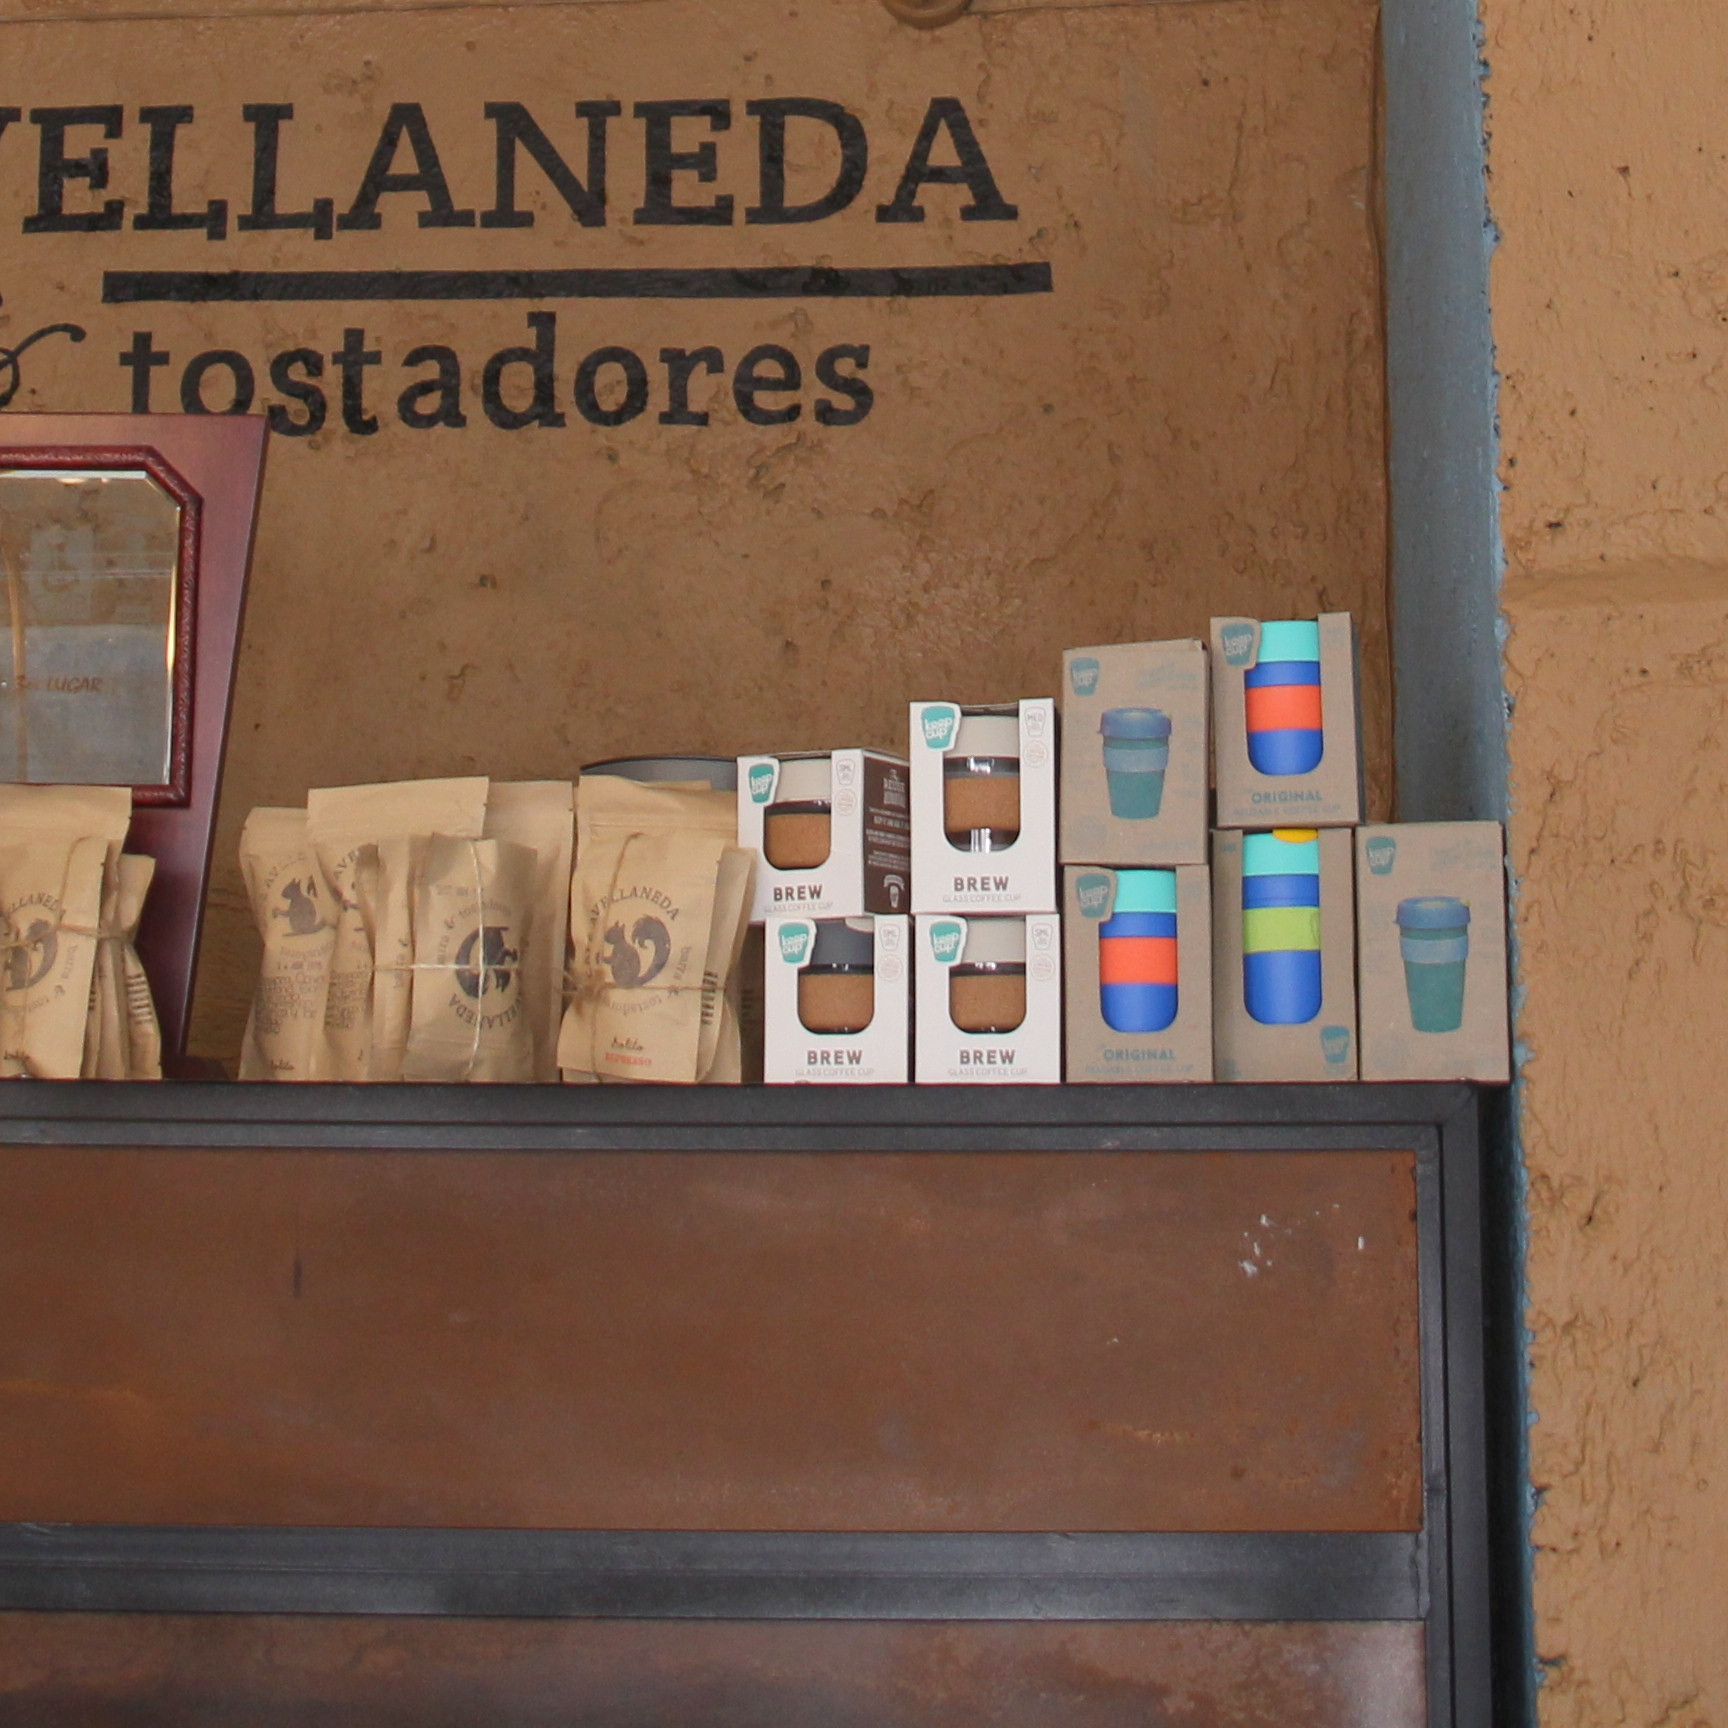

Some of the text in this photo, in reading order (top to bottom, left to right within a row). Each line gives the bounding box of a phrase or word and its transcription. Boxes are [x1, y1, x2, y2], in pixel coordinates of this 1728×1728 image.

[119, 311, 874, 438] tostadores
[925, 717, 953, 731] keep
[926, 728, 947, 740] cup
[1251, 790, 1323, 804] ORIGINAL
[953, 876, 1009, 892] BREW
[773, 884, 823, 902] BREW
[781, 933, 808, 945] keep
[933, 932, 960, 944] keep
[782, 942, 802, 955] cup
[934, 941, 955, 954] cup
[807, 1049, 863, 1065] BREW
[959, 1049, 1016, 1065] BREW
